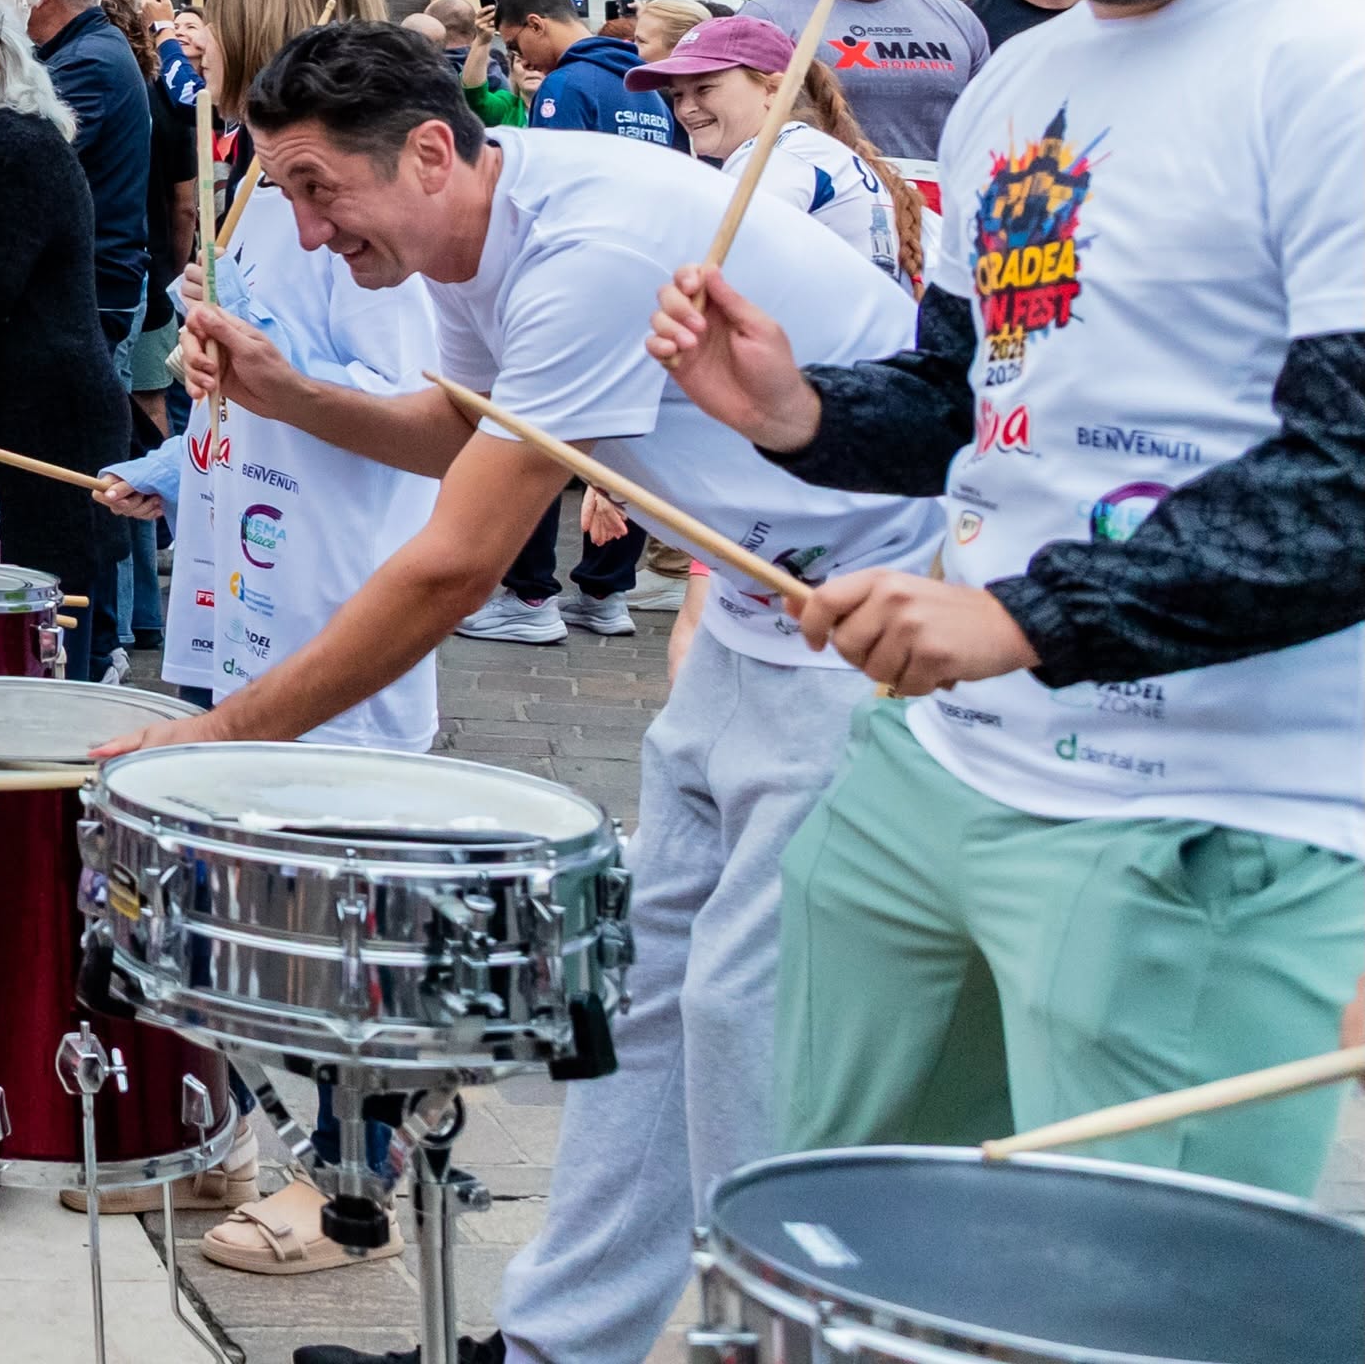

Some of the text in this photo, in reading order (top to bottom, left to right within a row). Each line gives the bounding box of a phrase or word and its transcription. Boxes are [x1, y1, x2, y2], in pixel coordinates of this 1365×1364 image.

[880, 60, 956, 72] ROMANIA
[615, 110, 637, 124] CSM
[976, 239, 1076, 296] ORADEA
[1012, 281, 1082, 331] FEST
[1076, 424, 1201, 463] BENVENUTI
[245, 627, 271, 649] ADEL
[1098, 693, 1165, 721] ZONE
[1081, 744, 1133, 772] dental
